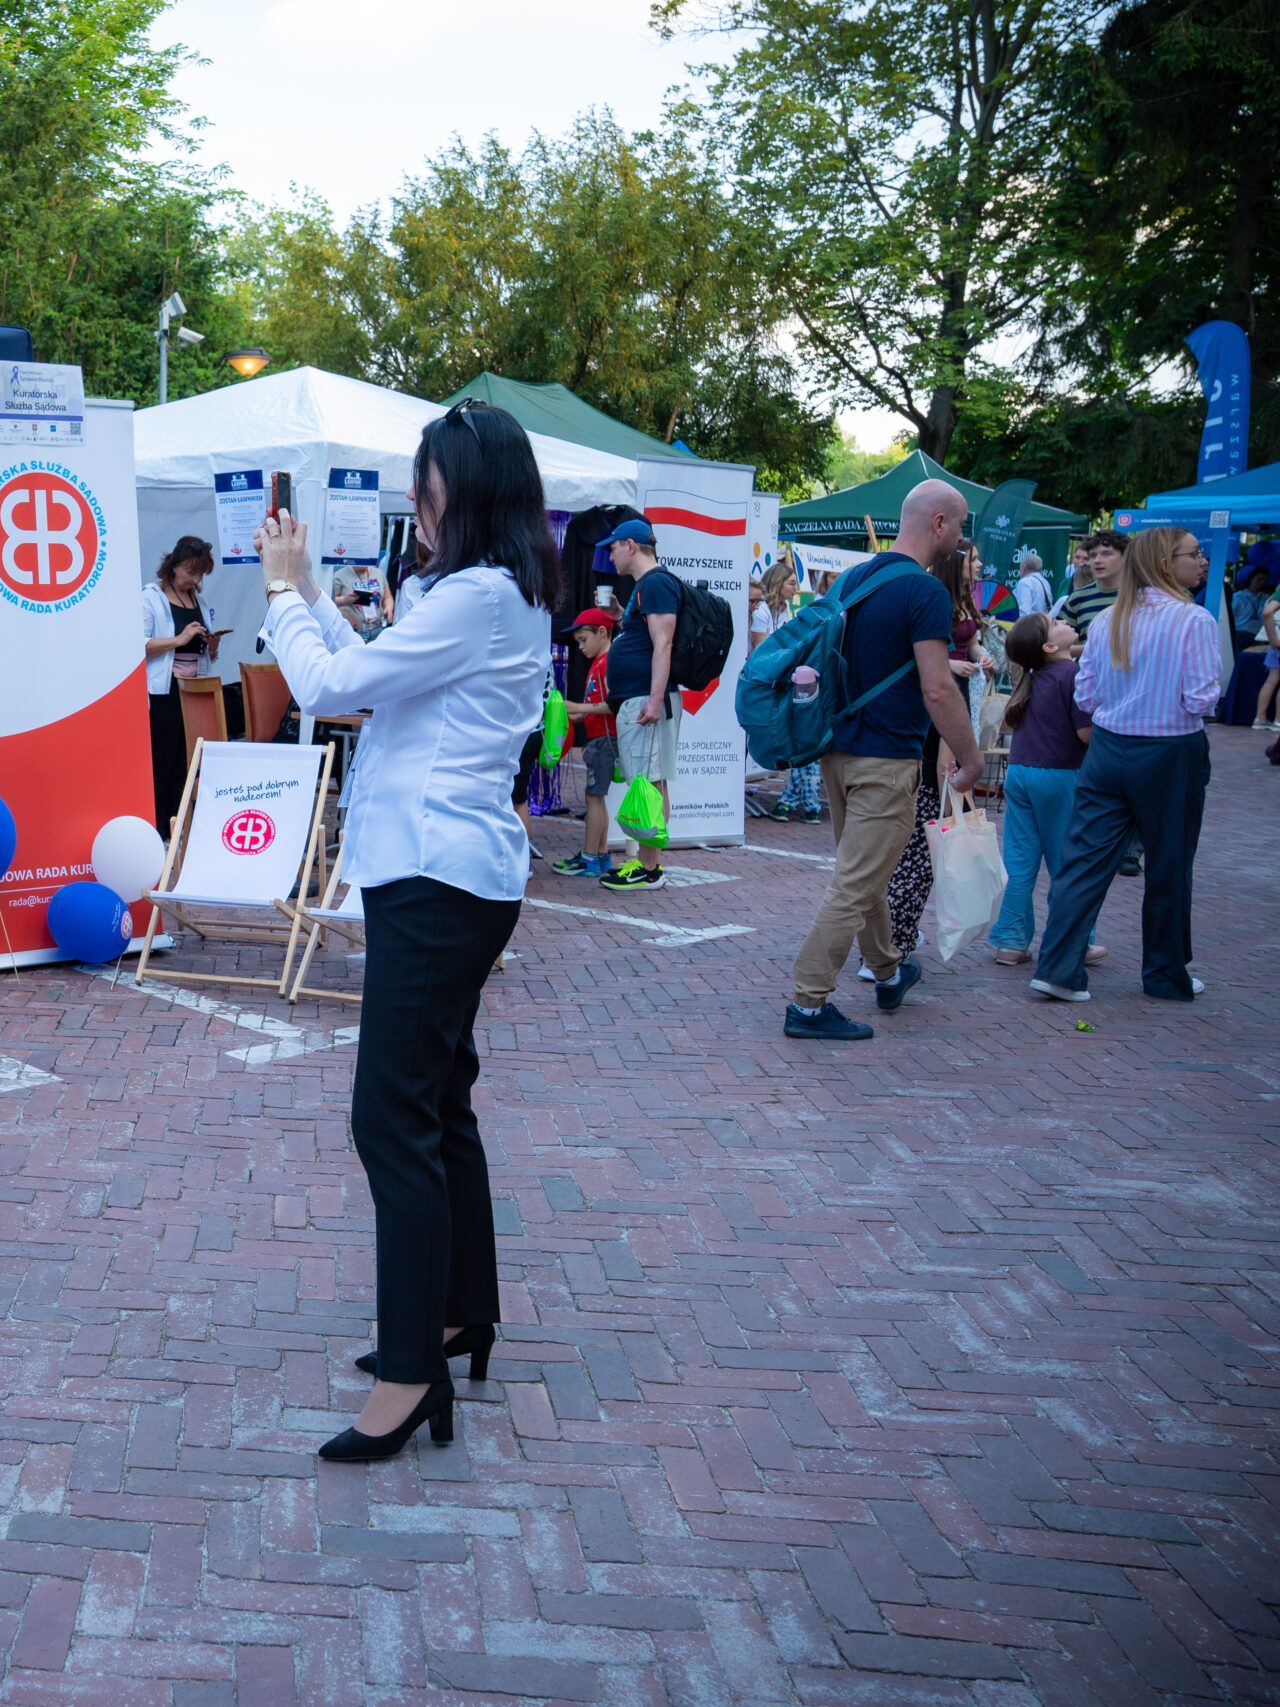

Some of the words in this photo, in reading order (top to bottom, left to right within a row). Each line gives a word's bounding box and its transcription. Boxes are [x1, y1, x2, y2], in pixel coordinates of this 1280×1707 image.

[13, 389, 58, 399] Kuratorska
[30, 460, 78, 486] SŁUŻBA
[78, 481, 107, 537] SĄDOWA
[785, 522, 833, 533] NACZELNA
[835, 520, 861, 531] RADA
[20, 600, 53, 614] RADA
[54, 549, 107, 613] KURATORÓW
[691, 741, 732, 750] SPOŁECZNY
[678, 754, 739, 763] PRZEDSTAWICIEL
[692, 767, 700, 775] W
[701, 766, 727, 776] SĄDZIE
[214, 785, 245, 799] jesteś
[247, 781, 263, 797] pod
[265, 778, 299, 790] dobrym
[234, 789, 282, 803] nadzorem!
[671, 802, 703, 810] Ławników
[36, 865, 68, 879] RADA
